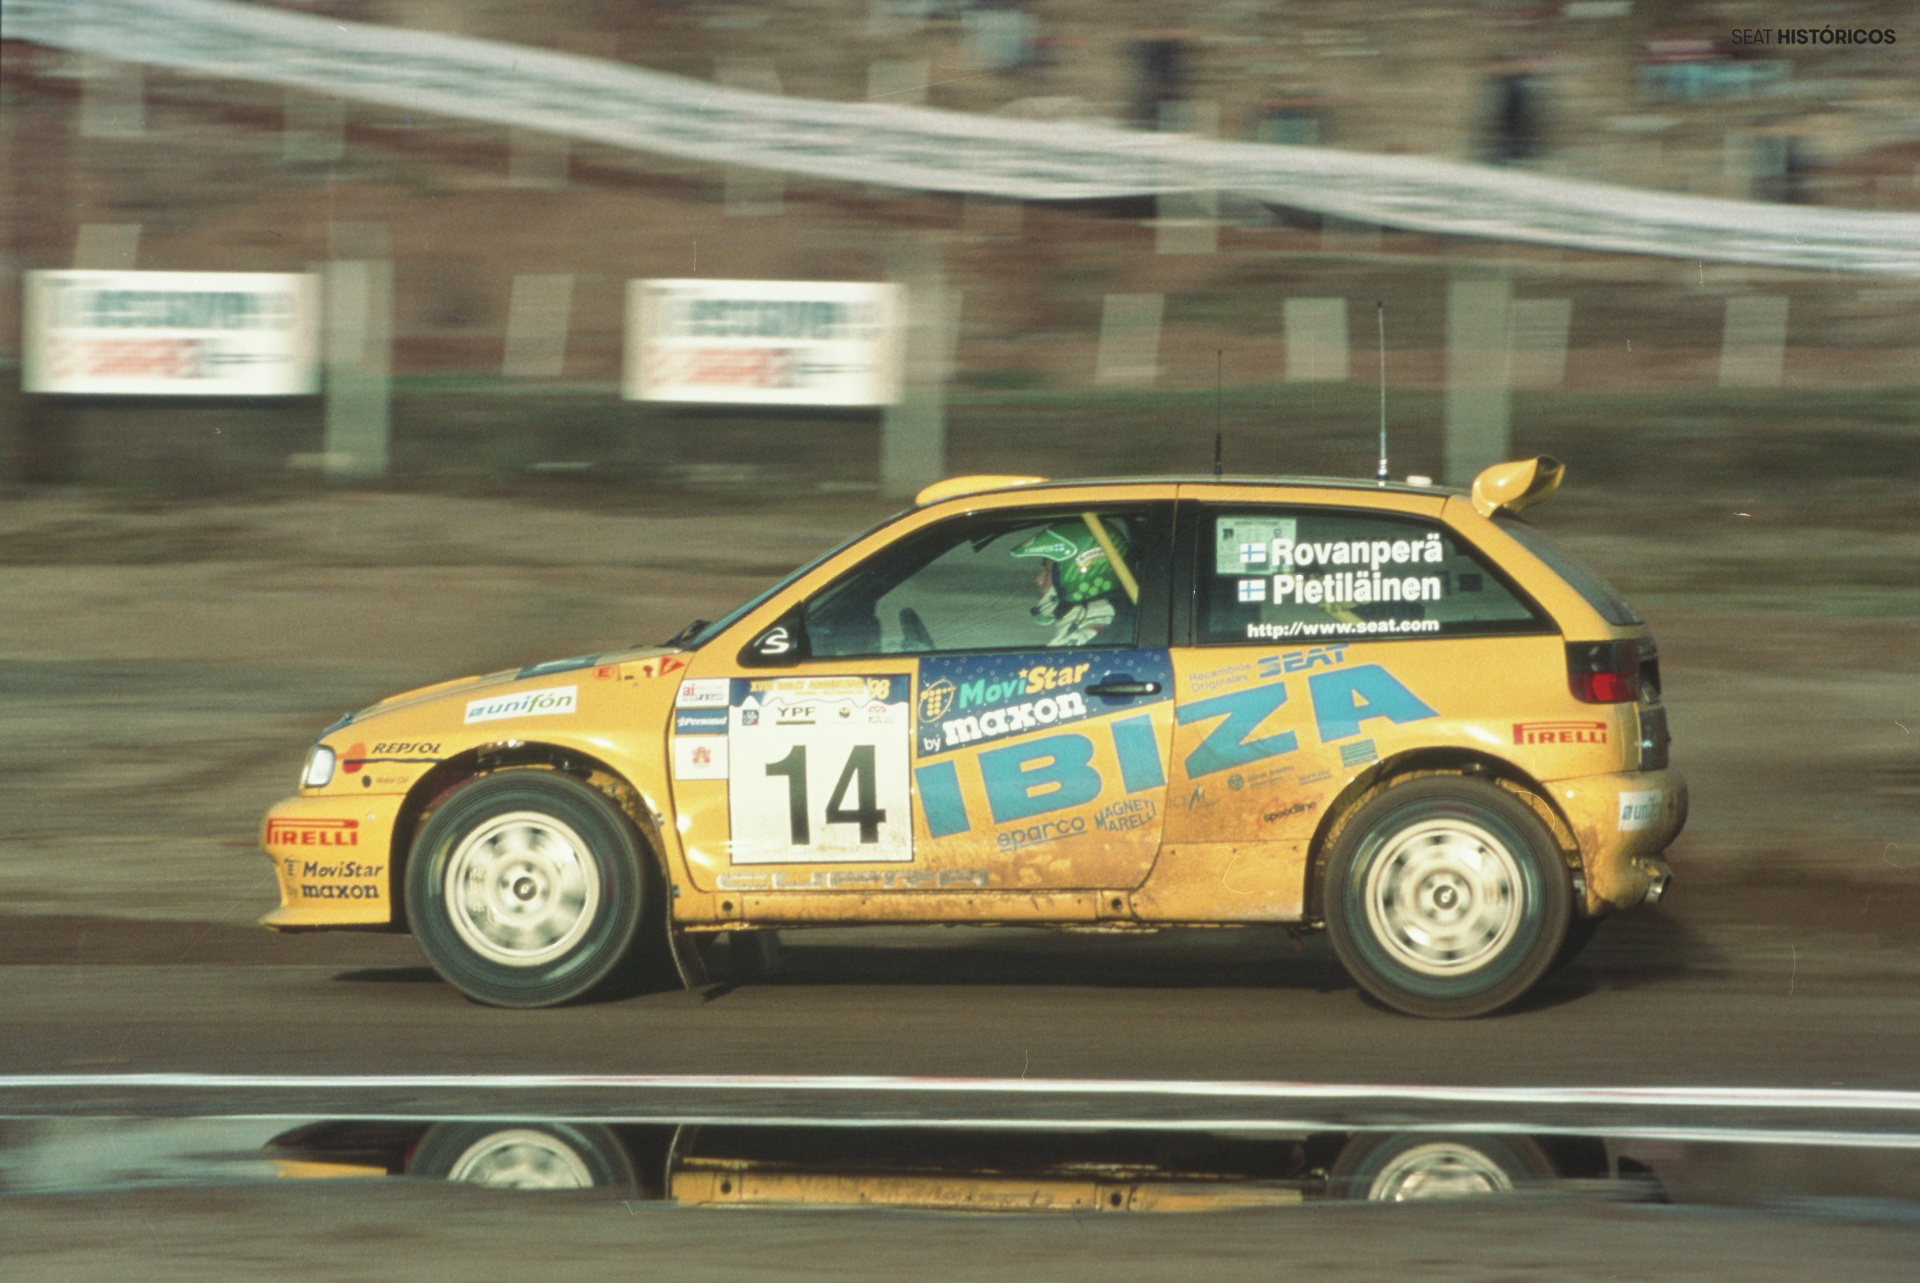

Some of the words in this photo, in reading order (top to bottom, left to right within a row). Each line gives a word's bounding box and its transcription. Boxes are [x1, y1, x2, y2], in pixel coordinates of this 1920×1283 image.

[1270, 533, 1443, 570] Rovanperä
[1273, 571, 1442, 604] Pietiläinen
[1246, 618, 1440, 639] http://www.seat.com
[1257, 644, 1350, 679] SEAT
[959, 663, 1090, 709] MoviStar
[486, 693, 573, 715] unifón
[777, 706, 816, 717] YPF
[923, 737, 941, 751] by
[942, 692, 1087, 746] maxon
[1512, 720, 1608, 745] PIRELLI
[371, 742, 442, 754] REPSOL
[914, 663, 1441, 839] IBIZA
[765, 744, 887, 846] 14
[266, 817, 359, 846] PIRELLI
[997, 816, 1085, 849] sparco
[303, 861, 384, 877] MoviStar
[301, 884, 380, 899] maxon
